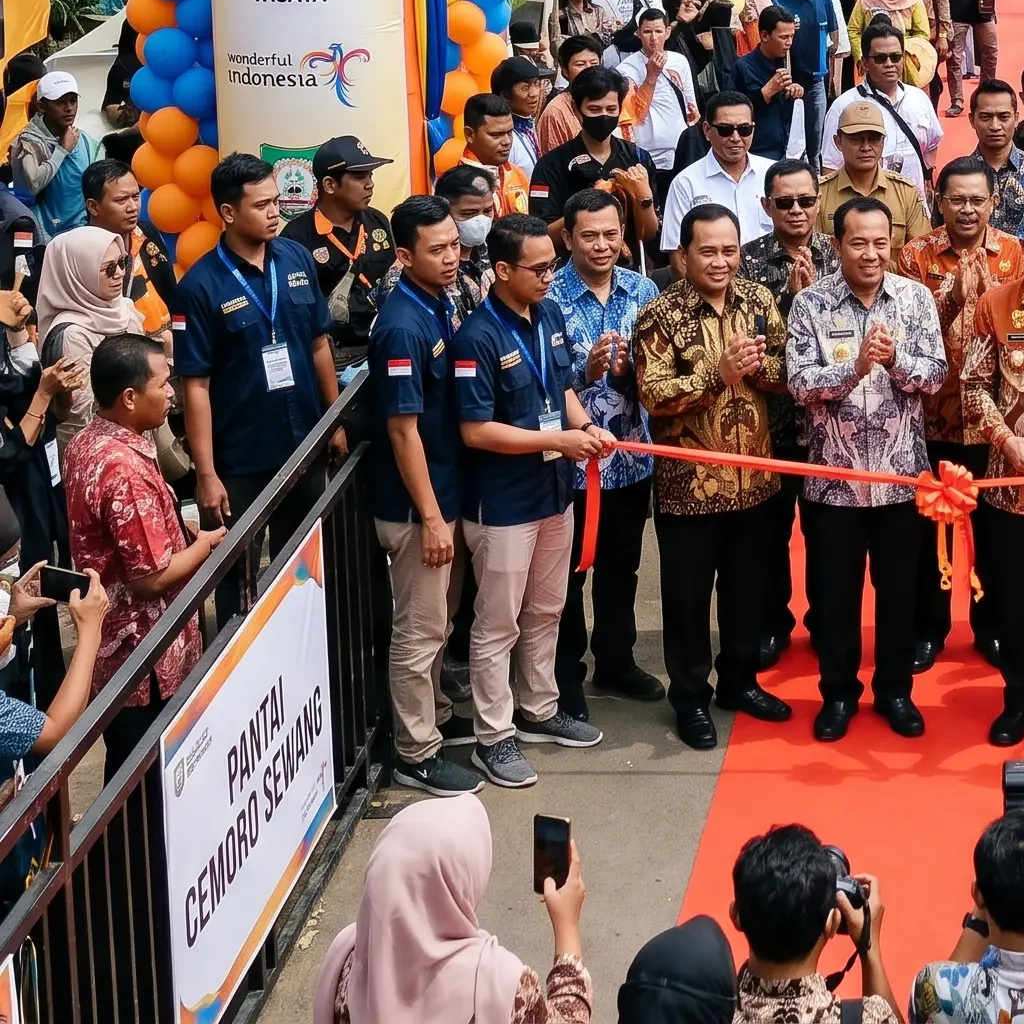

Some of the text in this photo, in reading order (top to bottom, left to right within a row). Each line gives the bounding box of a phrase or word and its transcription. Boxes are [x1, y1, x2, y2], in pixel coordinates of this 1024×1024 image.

[227, 53, 293, 67] wonderful
[228, 67, 318, 88] indonesia
[226, 674, 285, 808] PANTAI
[183, 788, 260, 949] CEMORO
[263, 684, 323, 824] SEWANG
